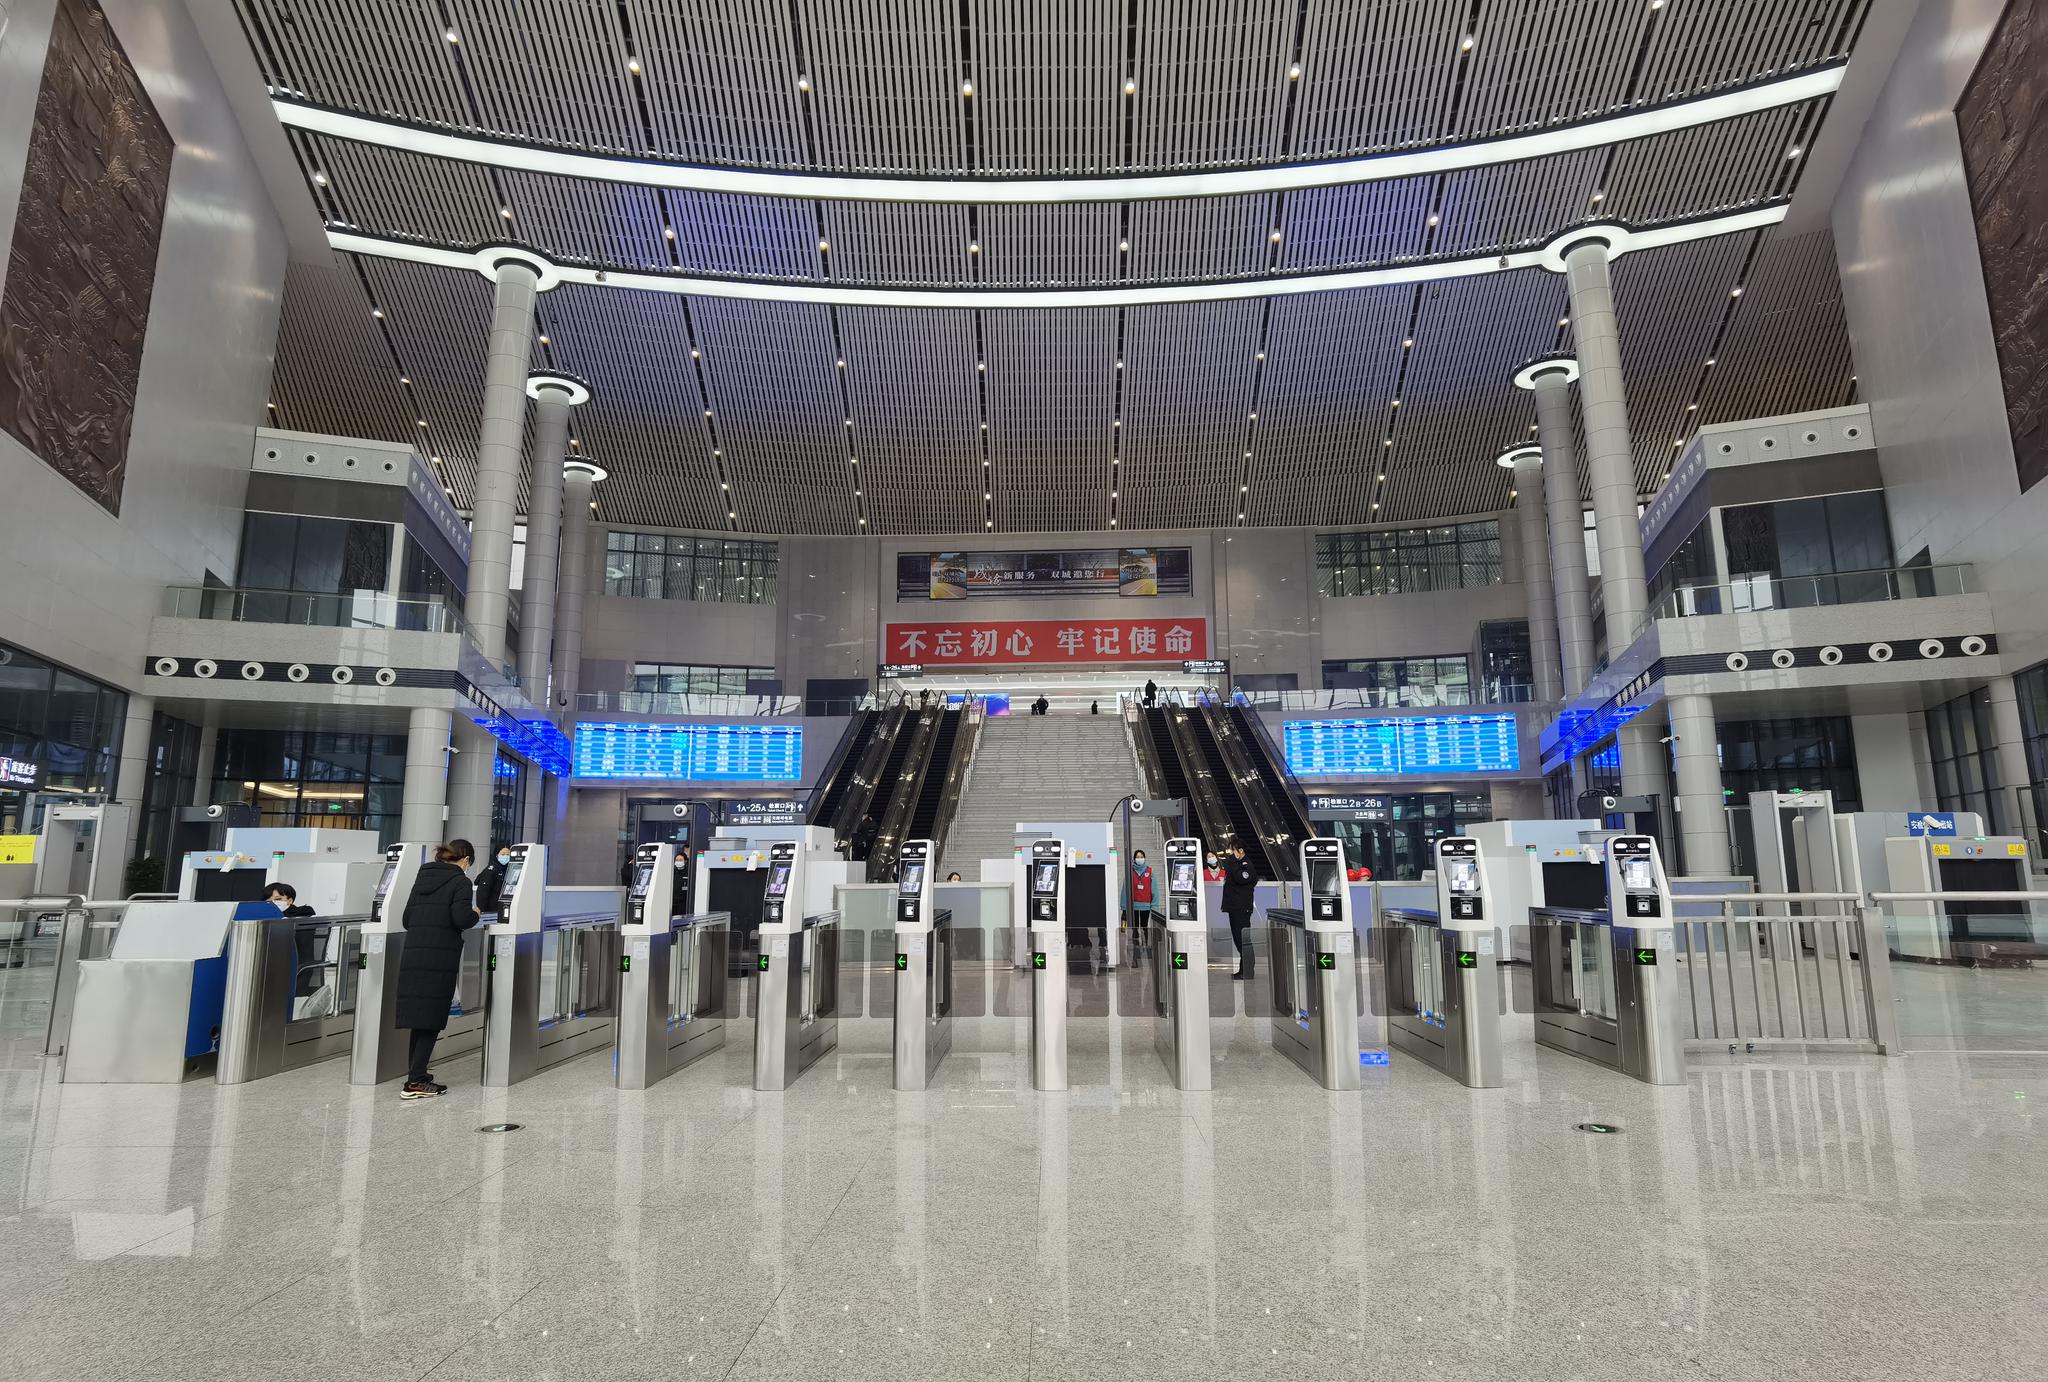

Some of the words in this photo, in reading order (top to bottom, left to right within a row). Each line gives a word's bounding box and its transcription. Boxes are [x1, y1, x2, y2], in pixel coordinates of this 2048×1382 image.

[899, 629, 1034, 658] 不忘初心
[1056, 625, 1194, 656] 牢记使命
[1349, 799, 1382, 807] 2B-26B
[737, 804, 767, 812] 1A-25A
